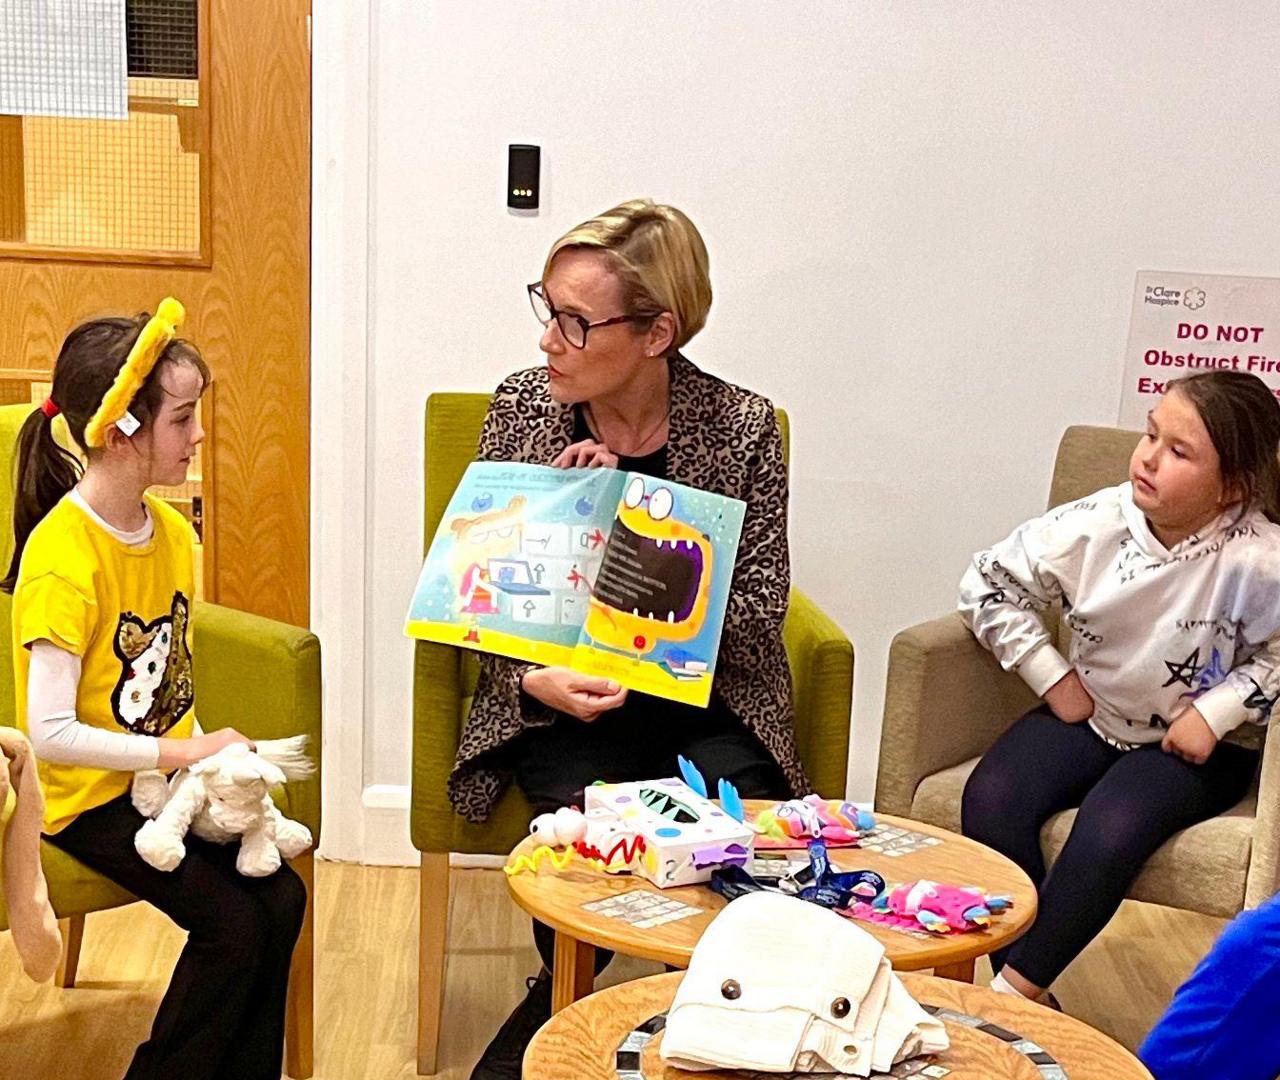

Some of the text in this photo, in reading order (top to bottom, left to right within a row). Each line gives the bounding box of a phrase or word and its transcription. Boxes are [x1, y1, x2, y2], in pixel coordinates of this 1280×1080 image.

[1153, 286, 1181, 298] Clare
[1144, 296, 1180, 307] Hospice
[1177, 323, 1264, 344] DO NOT
[1144, 350, 1240, 371] Obstruct
